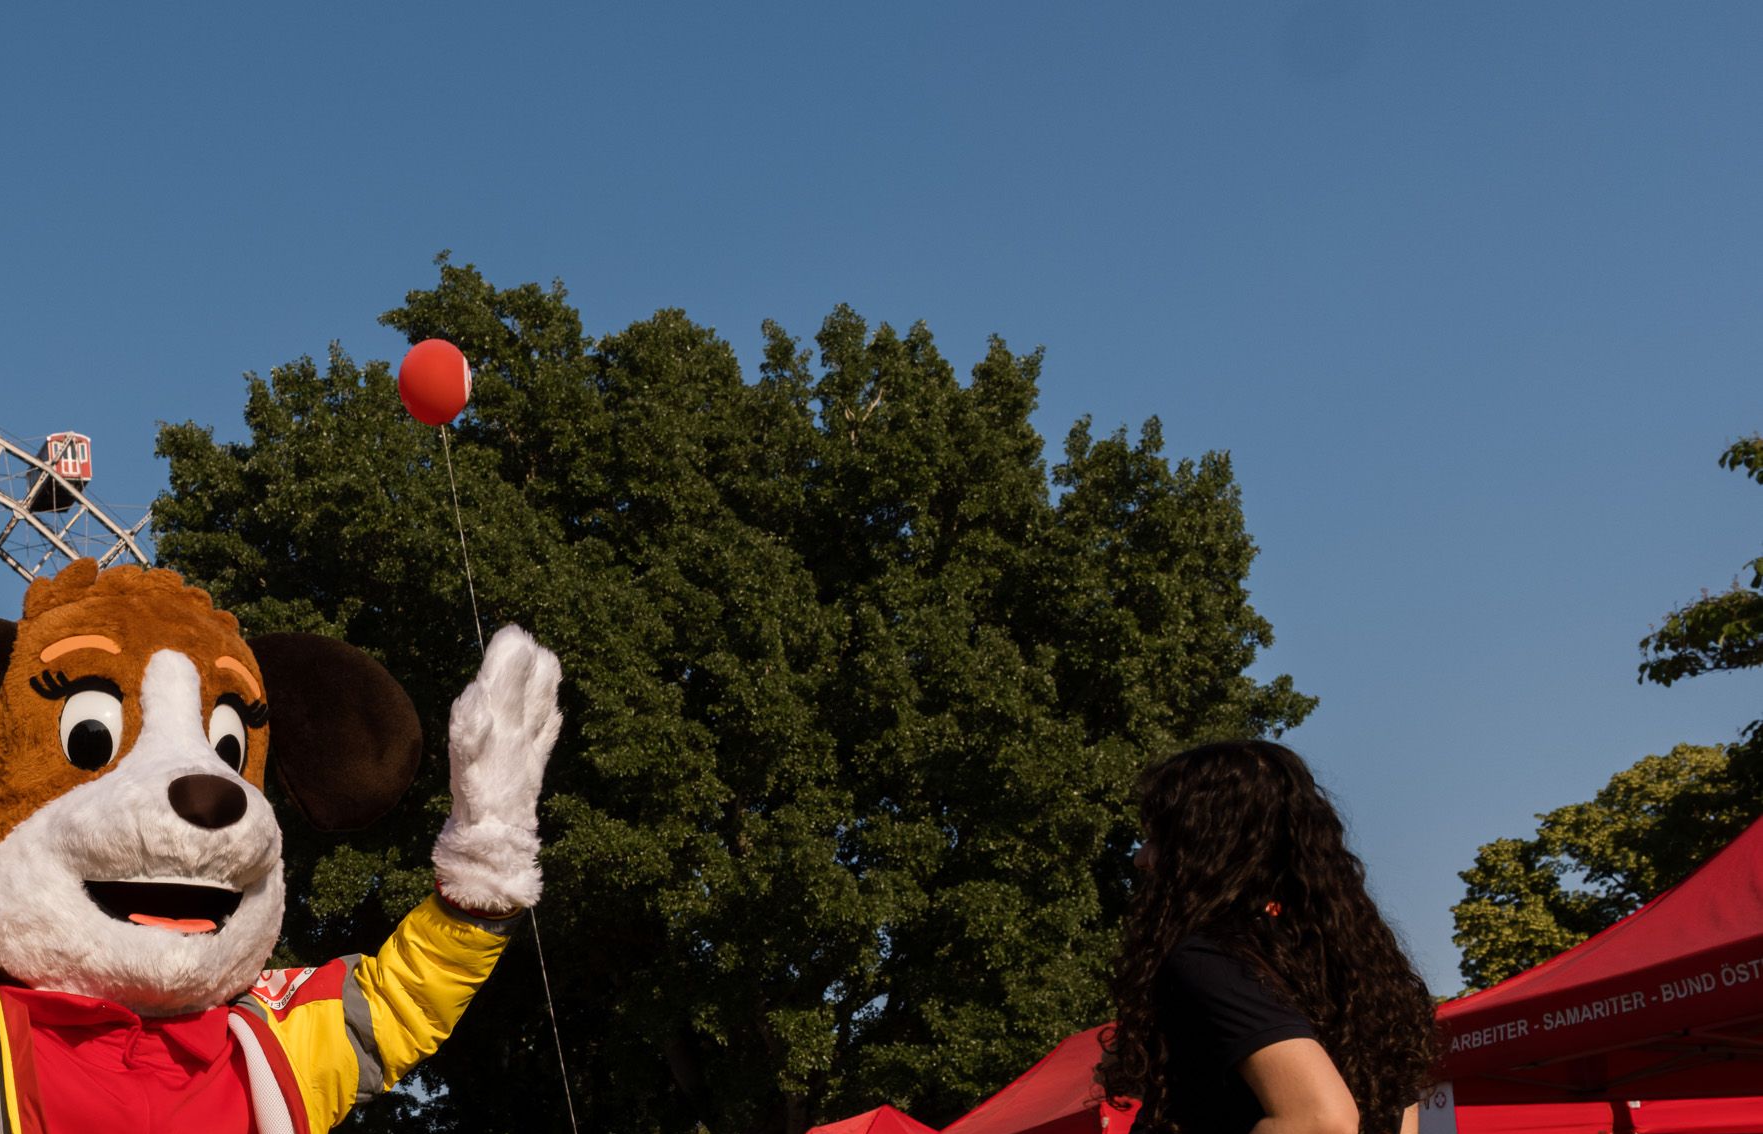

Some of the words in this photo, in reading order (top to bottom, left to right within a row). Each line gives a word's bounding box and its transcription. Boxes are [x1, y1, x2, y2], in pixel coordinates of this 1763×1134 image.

[1449, 1018, 1529, 1054] ARBEITER
[1542, 991, 1646, 1032] SAMARITER
[1660, 972, 1717, 1004] BUND
[1720, 957, 1763, 988] ÖST
